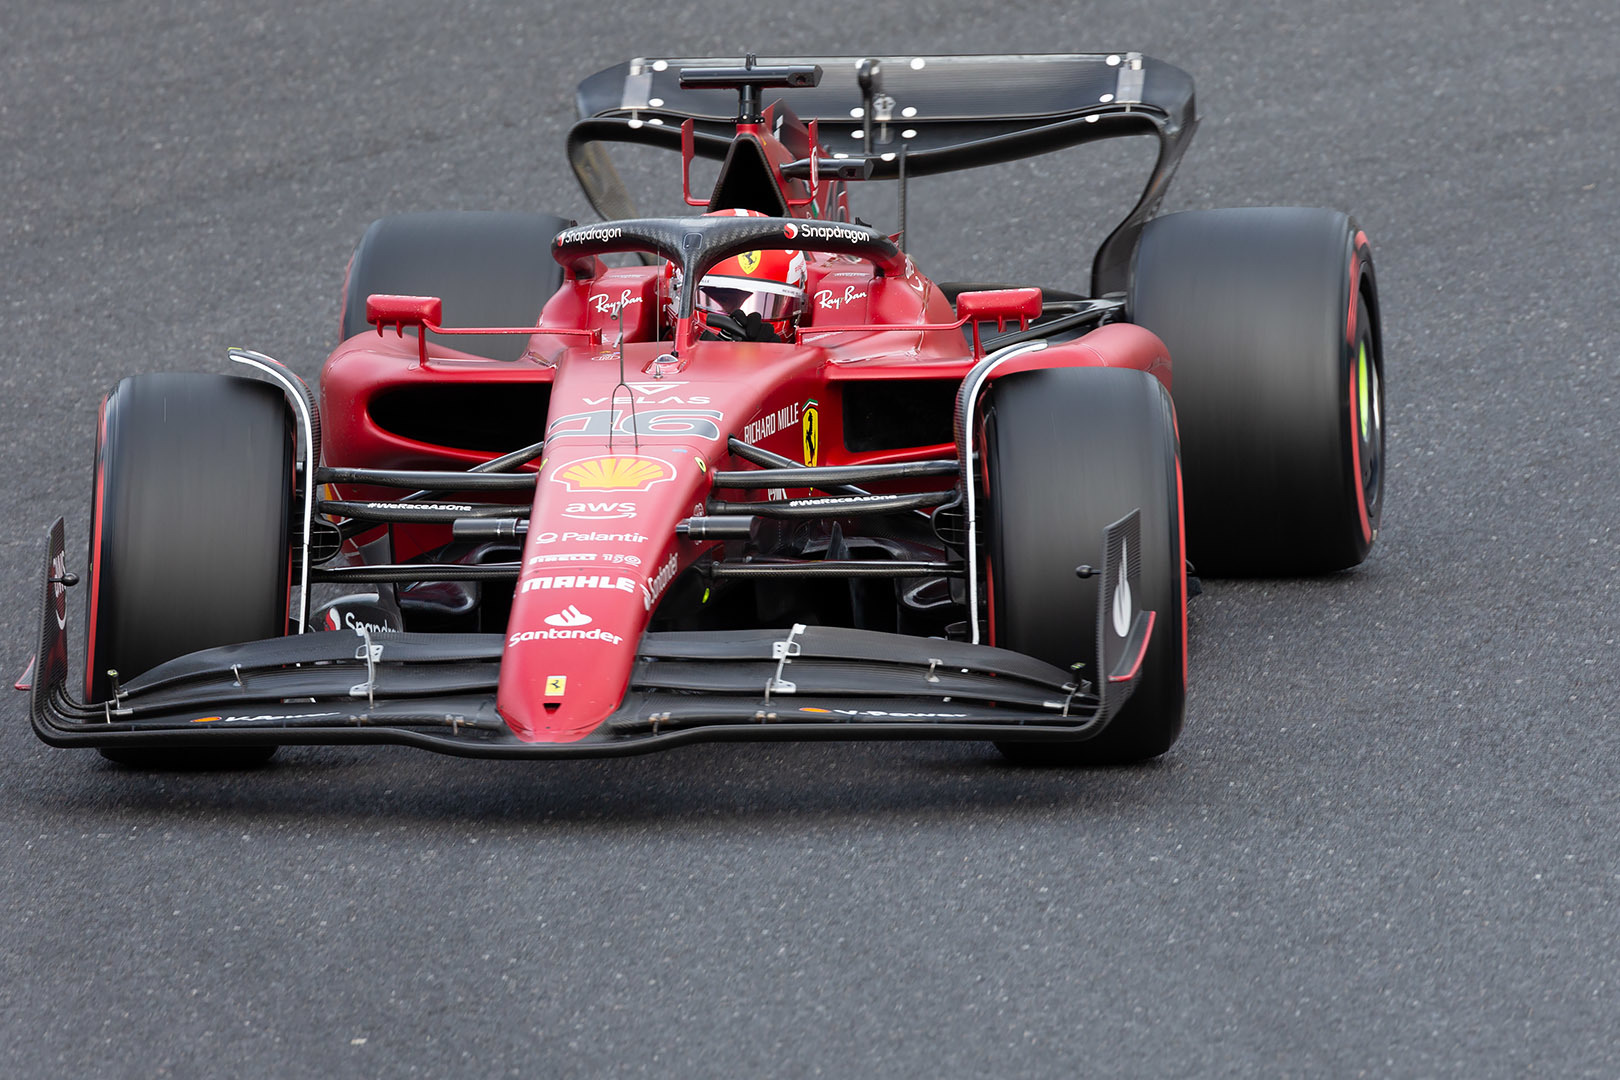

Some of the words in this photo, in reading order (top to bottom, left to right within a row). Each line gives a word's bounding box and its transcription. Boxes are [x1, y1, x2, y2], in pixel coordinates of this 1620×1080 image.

[565, 227, 622, 244] Snapdragon
[801, 224, 870, 243] Snapdragon
[814, 286, 867, 309] Ray-Ban
[582, 396, 711, 405] VELAS
[546, 409, 723, 446] 16
[744, 412, 776, 445] RICHARD
[777, 402, 799, 431] MILLE
[565, 502, 636, 513] aws
[561, 531, 649, 543] Palantir
[521, 576, 636, 593] MAHLE
[508, 628, 623, 647] Santander
